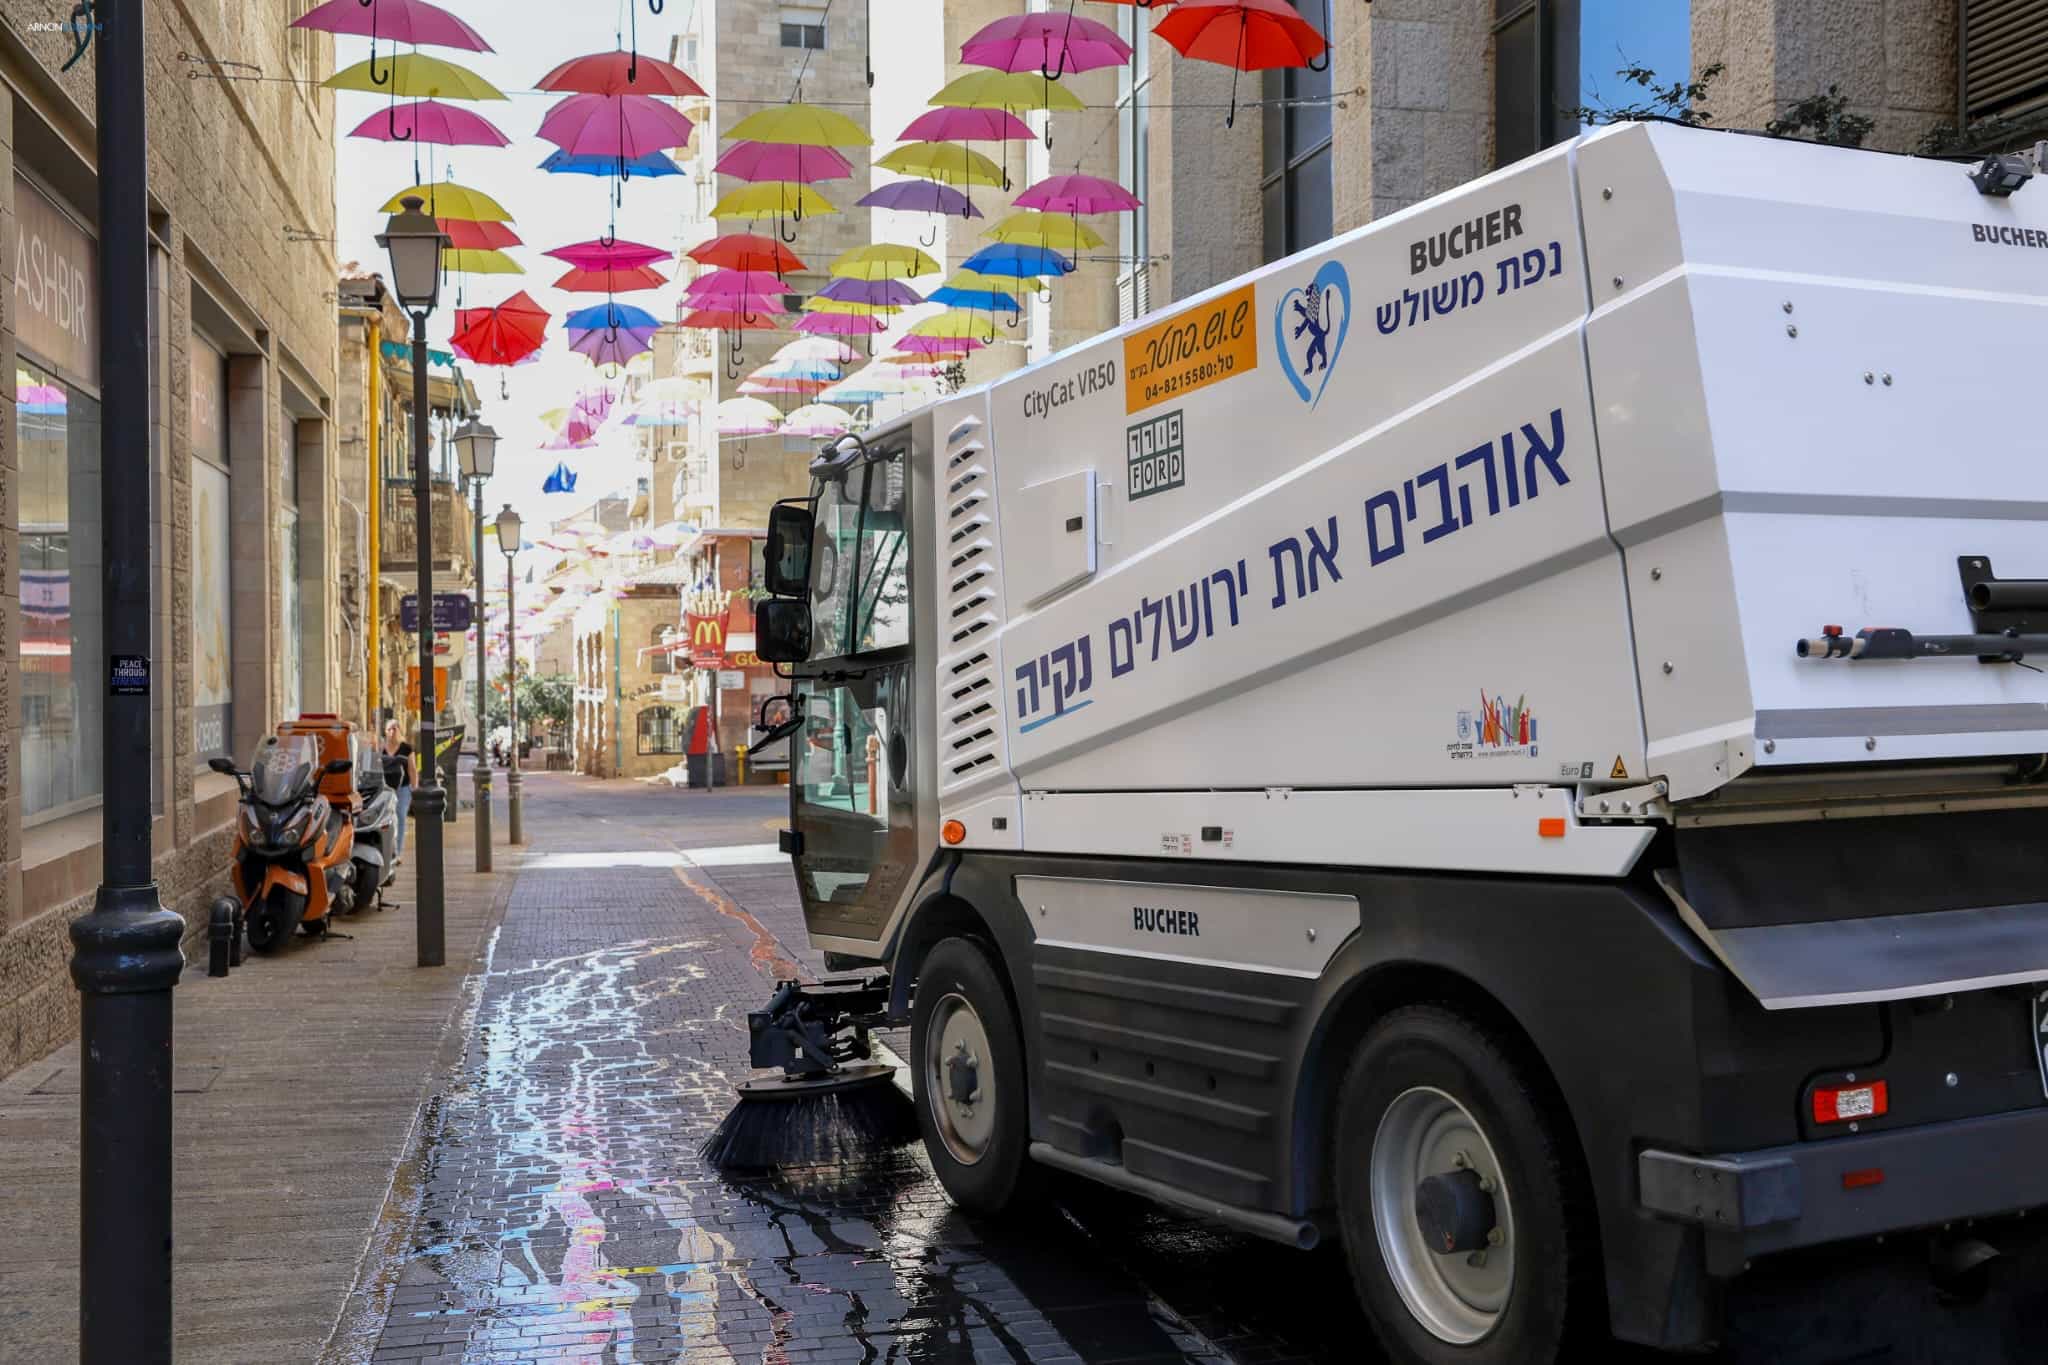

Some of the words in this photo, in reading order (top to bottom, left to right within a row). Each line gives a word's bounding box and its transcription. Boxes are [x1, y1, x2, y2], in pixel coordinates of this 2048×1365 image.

[1410, 203, 1524, 276] BUCHER
[1972, 223, 2048, 249] BUCHER
[1496, 241, 1562, 296] נפת
[1376, 270, 1485, 335] משולש
[1023, 379, 1075, 420] CityCat
[1077, 359, 1116, 397] VR50
[1131, 420, 1179, 453] פורד
[1133, 454, 1181, 490] FORD
[1364, 407, 1571, 568] אוהבים
[1268, 515, 1343, 610] את
[1108, 559, 1249, 679] ירושלים
[1015, 634, 1093, 718] נקיה
[1133, 906, 1200, 937] BUCHER
